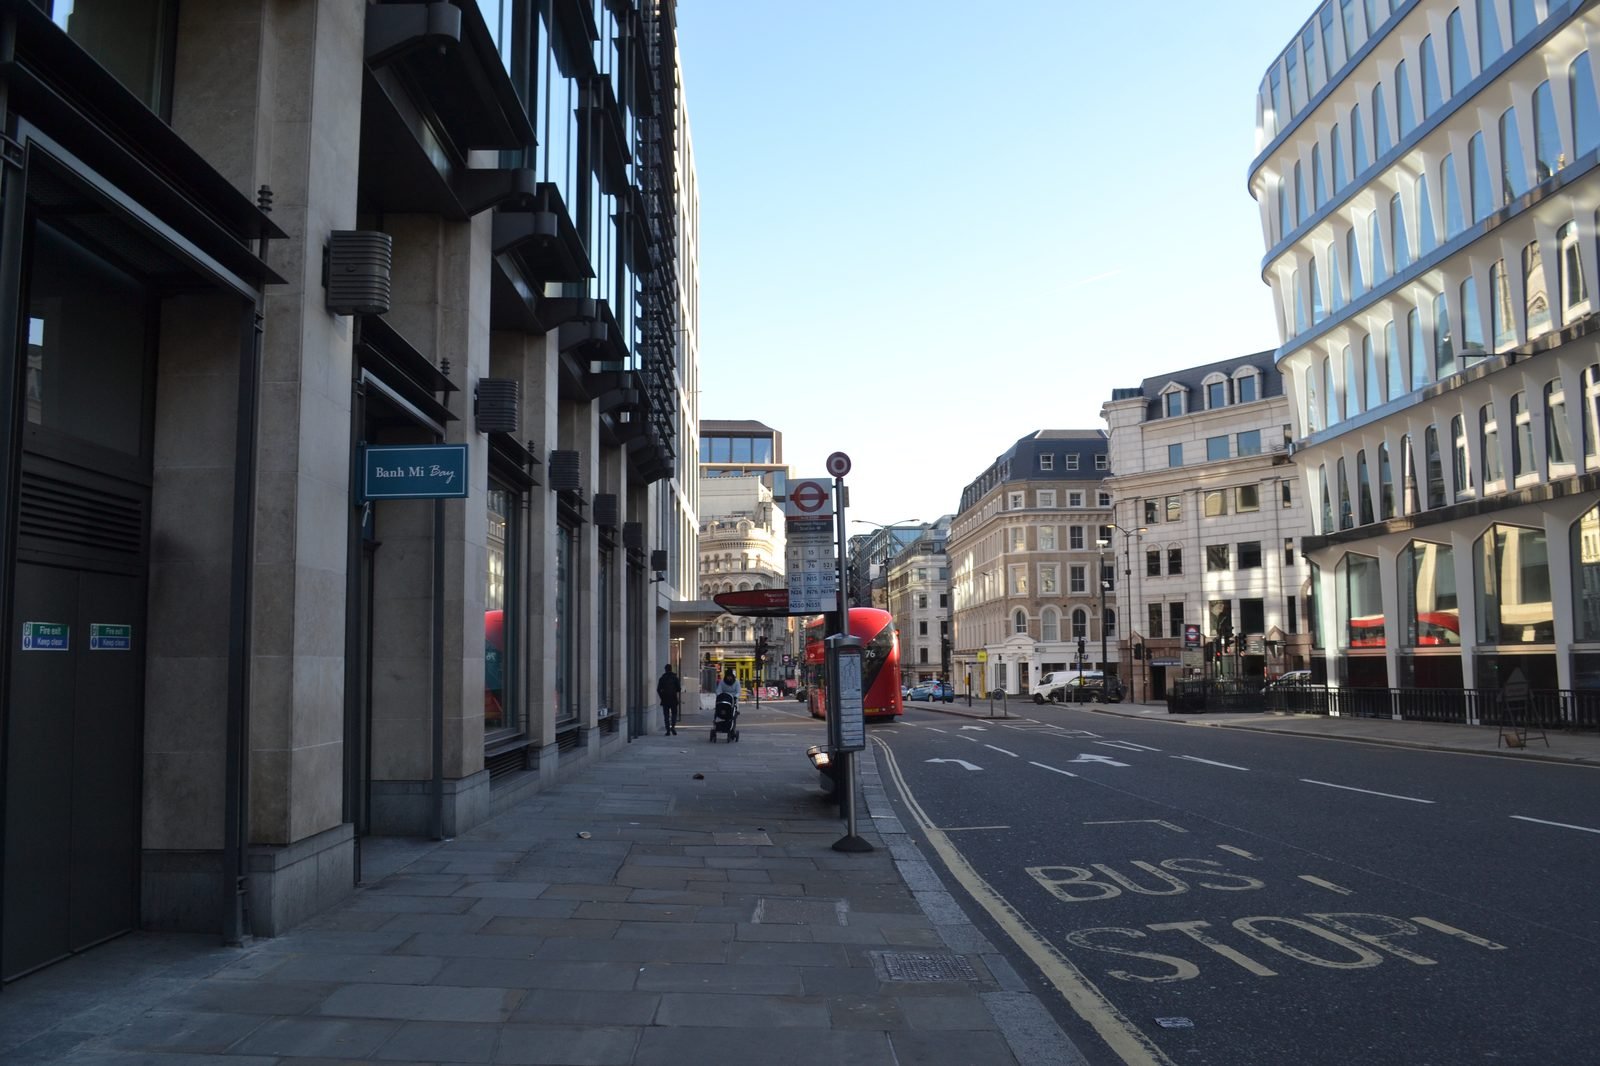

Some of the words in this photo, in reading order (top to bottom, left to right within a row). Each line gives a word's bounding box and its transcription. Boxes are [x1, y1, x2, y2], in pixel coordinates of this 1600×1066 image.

[375, 467, 405, 478] Banh
[408, 466, 424, 477] Mi
[429, 464, 455, 484] Bay
[39, 626, 50, 635] Fire
[51, 626, 61, 635] exit
[105, 627, 114, 635] Fire
[37, 637, 50, 647] Keep
[51, 638, 63, 646] clear
[102, 638, 114, 647] Keep
[115, 638, 125, 646] clear
[865, 650, 876, 658] 76
[1025, 856, 1265, 902] BUS
[1065, 912, 1438, 984] STOP
